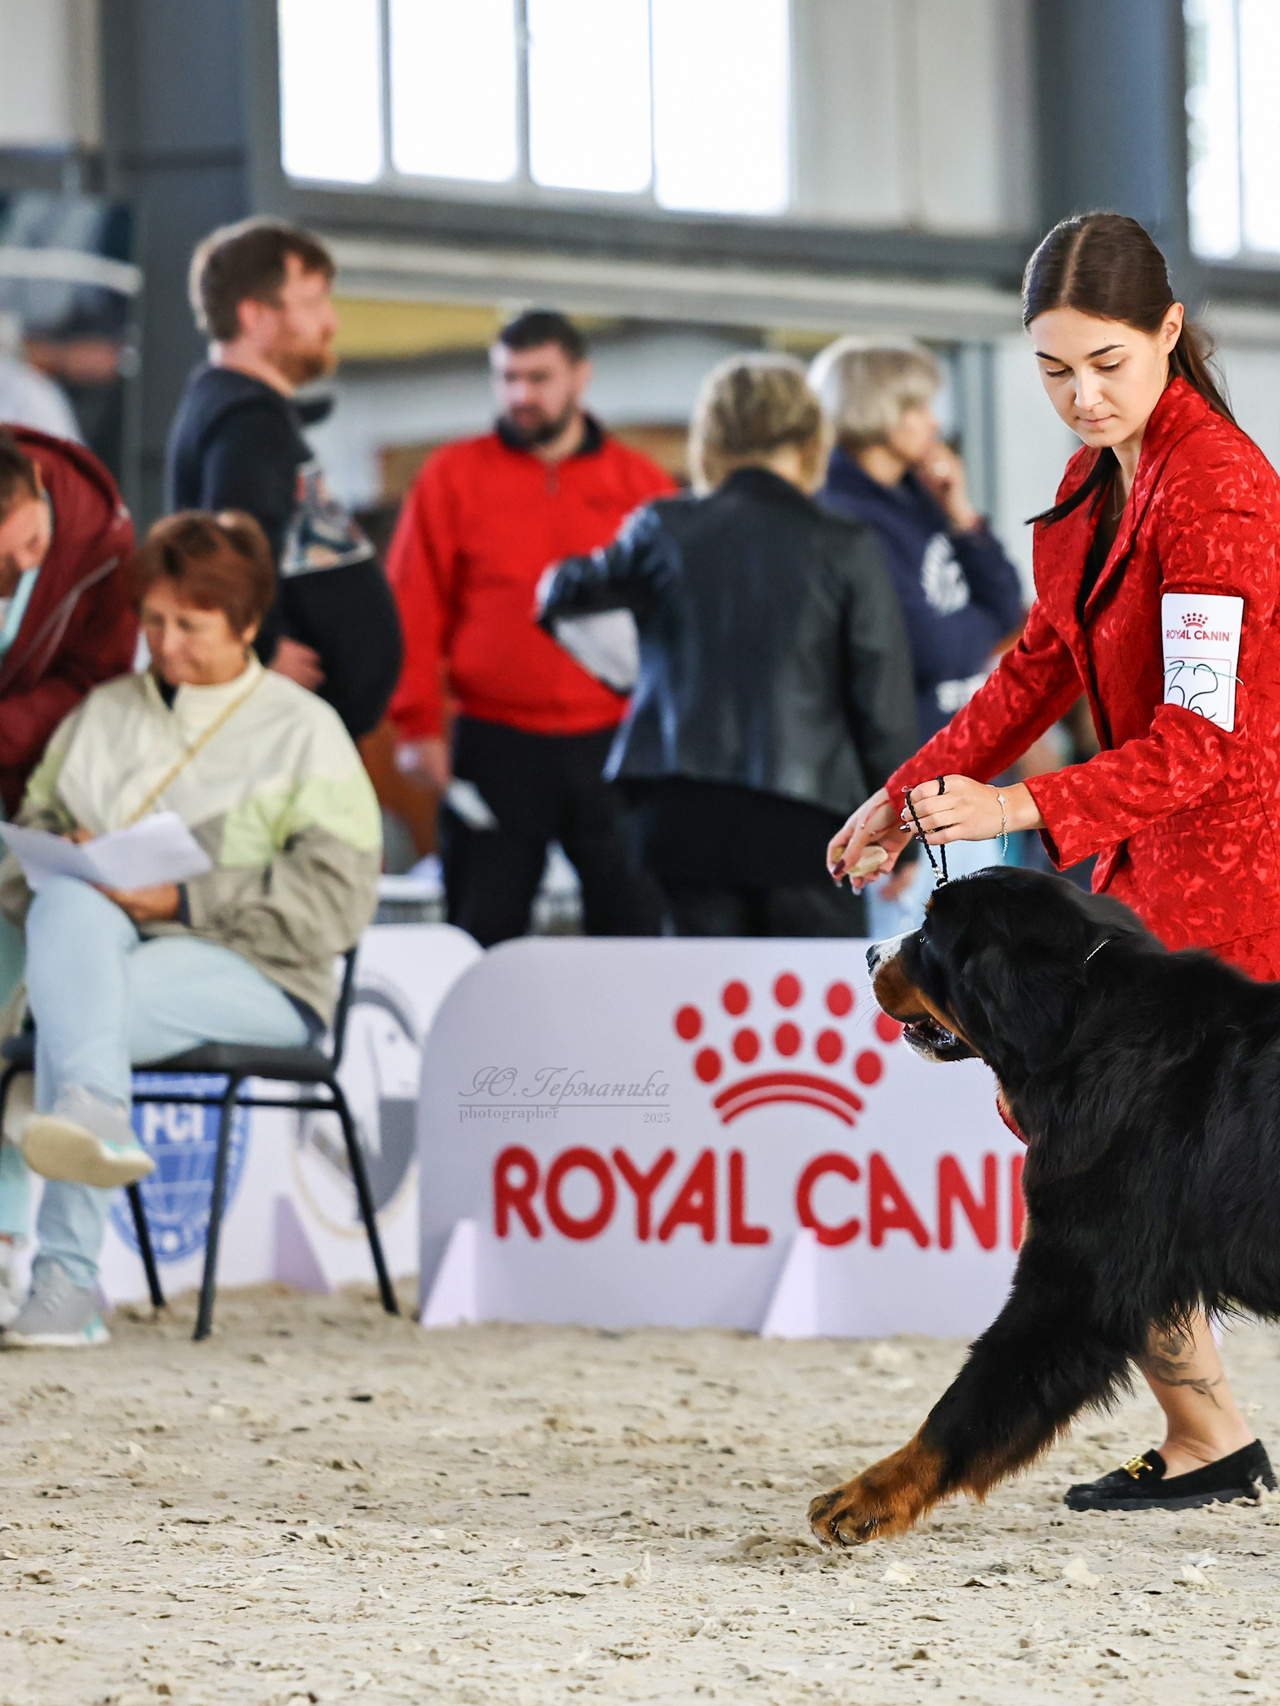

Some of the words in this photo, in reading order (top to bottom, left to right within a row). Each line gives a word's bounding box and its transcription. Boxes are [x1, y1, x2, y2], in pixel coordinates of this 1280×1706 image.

[1166, 630, 1191, 640] ROYAL
[1194, 630, 1230, 642] CANIN
[493, 1144, 770, 1245] ROYAL
[795, 1150, 1026, 1251] CANI
